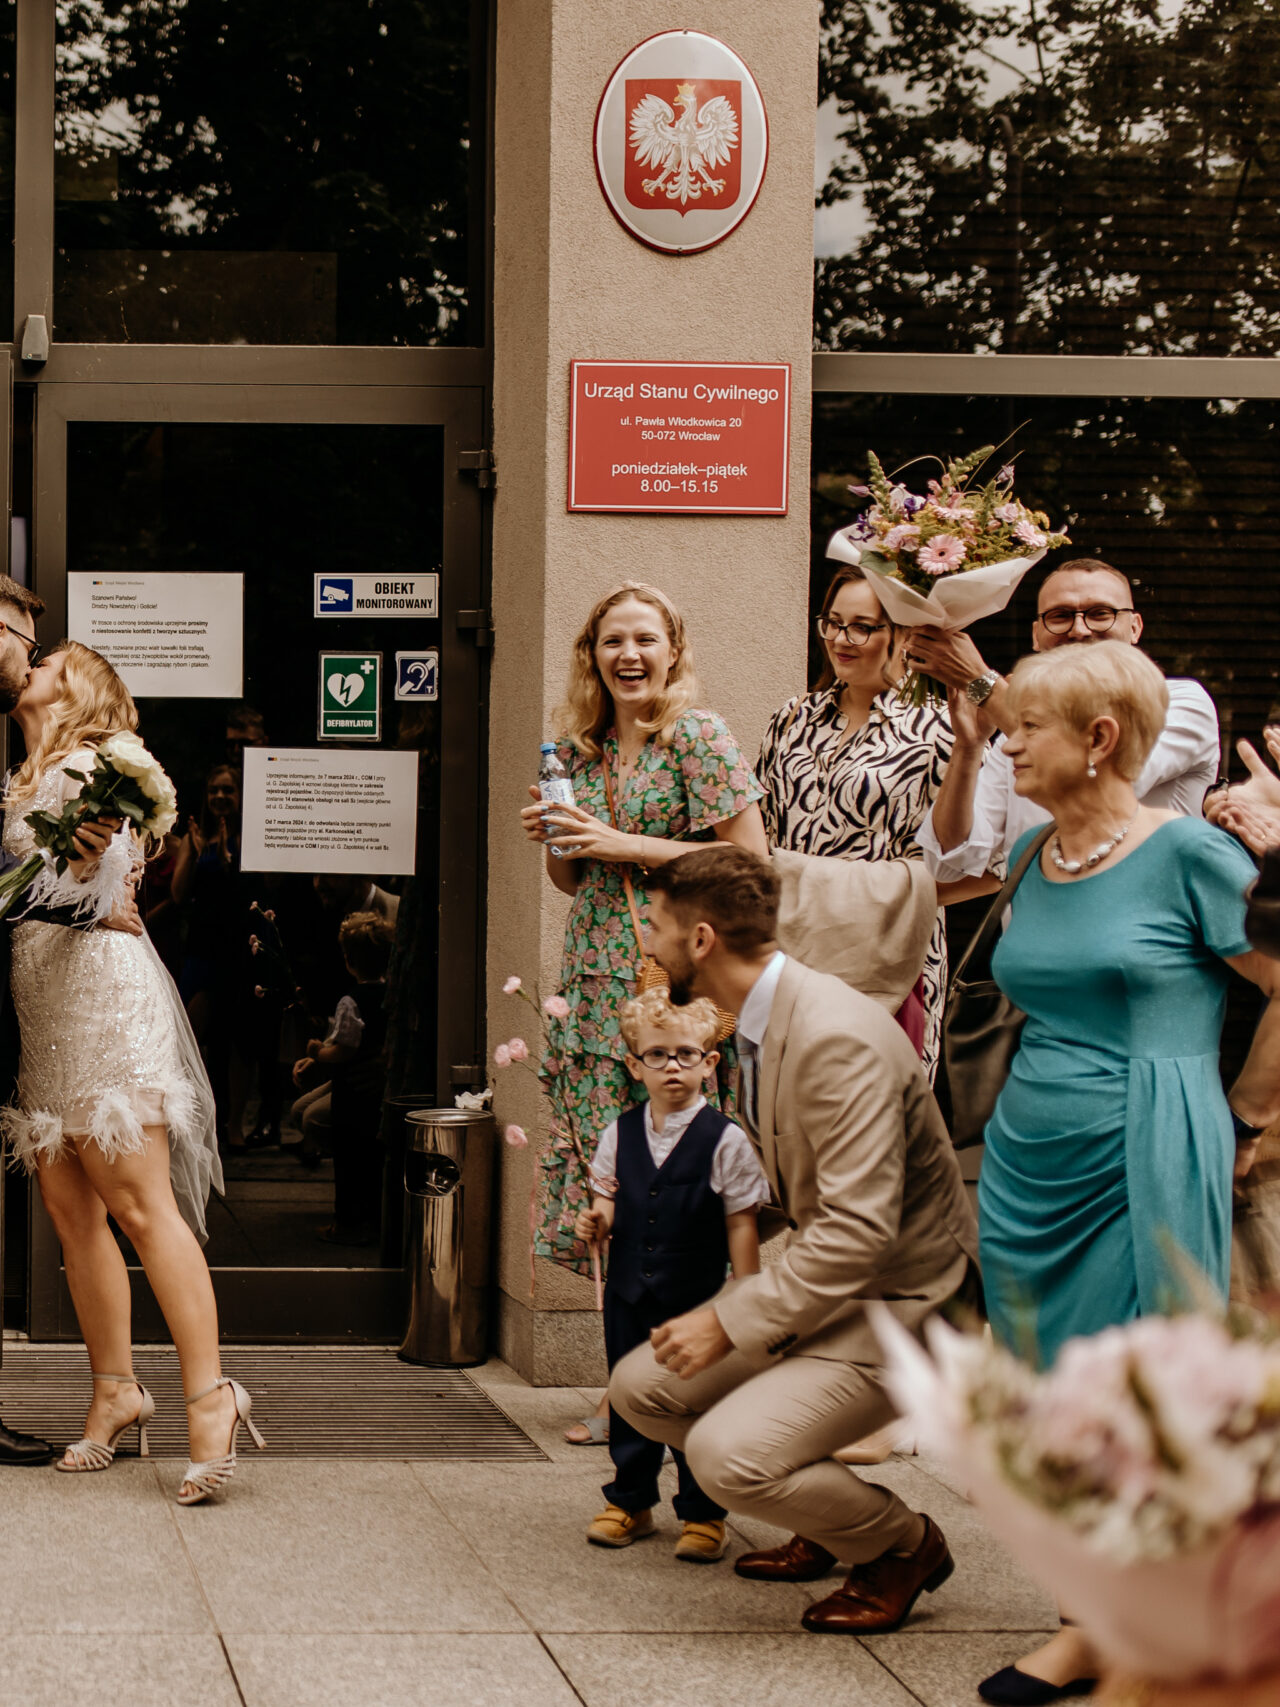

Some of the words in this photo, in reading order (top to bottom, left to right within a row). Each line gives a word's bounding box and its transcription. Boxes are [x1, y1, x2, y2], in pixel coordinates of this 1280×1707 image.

[584, 383, 634, 401] Urząd
[640, 384, 688, 399] Stanu
[693, 384, 779, 404] Cywilnego
[620, 416, 632, 426] ul.
[635, 417, 665, 426] Pawła
[668, 417, 726, 427] Włodkowica
[729, 418, 742, 427] 20
[641, 431, 675, 440] 50-072
[678, 431, 720, 441] Wrocław
[375, 582, 415, 594] OBIEKT
[356, 599, 433, 609] MONITOROWANY
[326, 719, 373, 727] DEFIBRYLATOR
